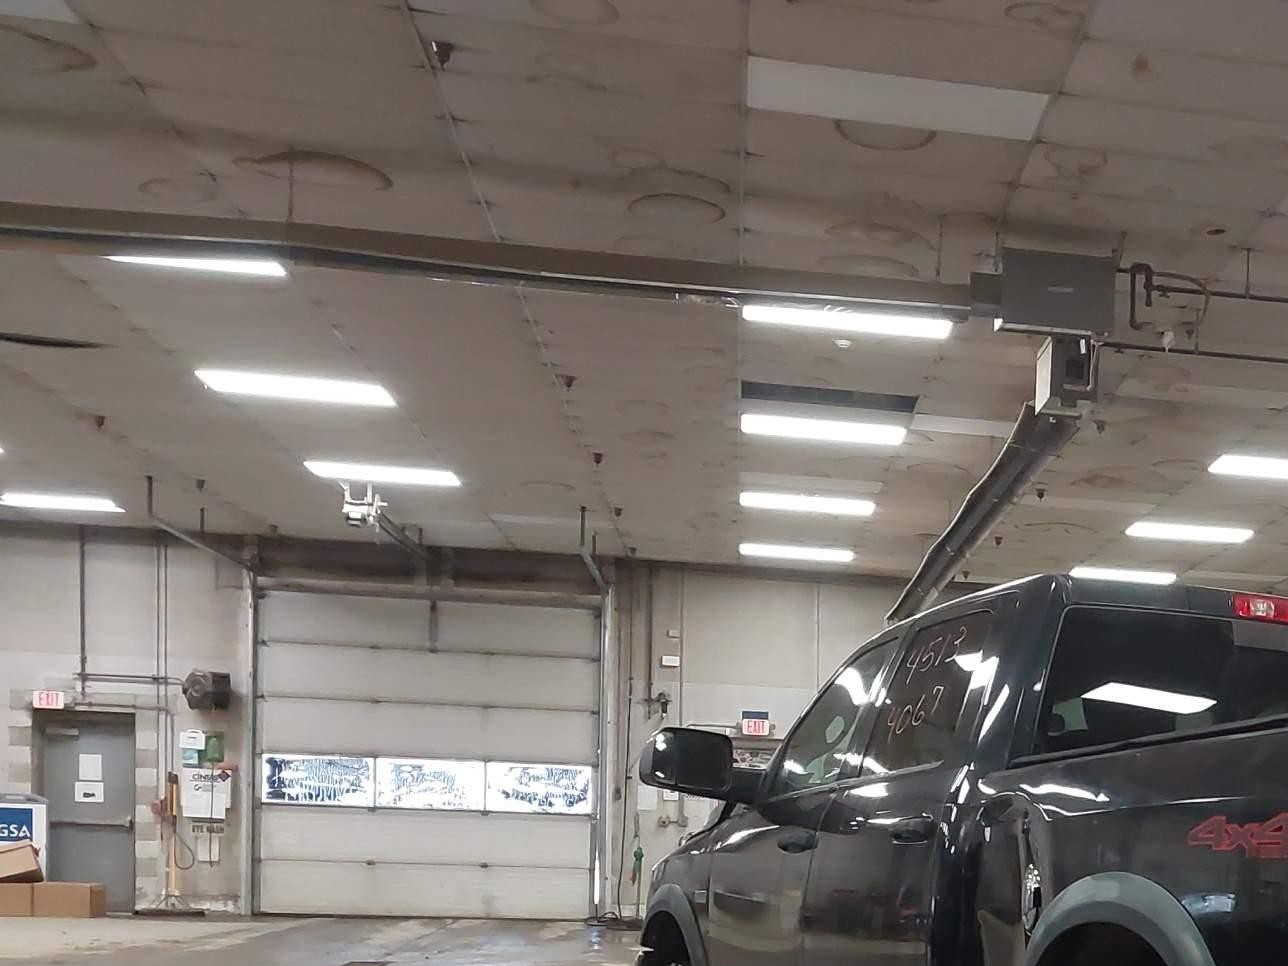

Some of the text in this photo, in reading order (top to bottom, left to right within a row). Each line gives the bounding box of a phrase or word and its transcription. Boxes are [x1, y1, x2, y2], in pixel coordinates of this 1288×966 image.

[39, 691, 59, 706] EXIT
[888, 686, 944, 744] 4067
[747, 720, 766, 733] EXIT
[0, 823, 31, 837] GSA
